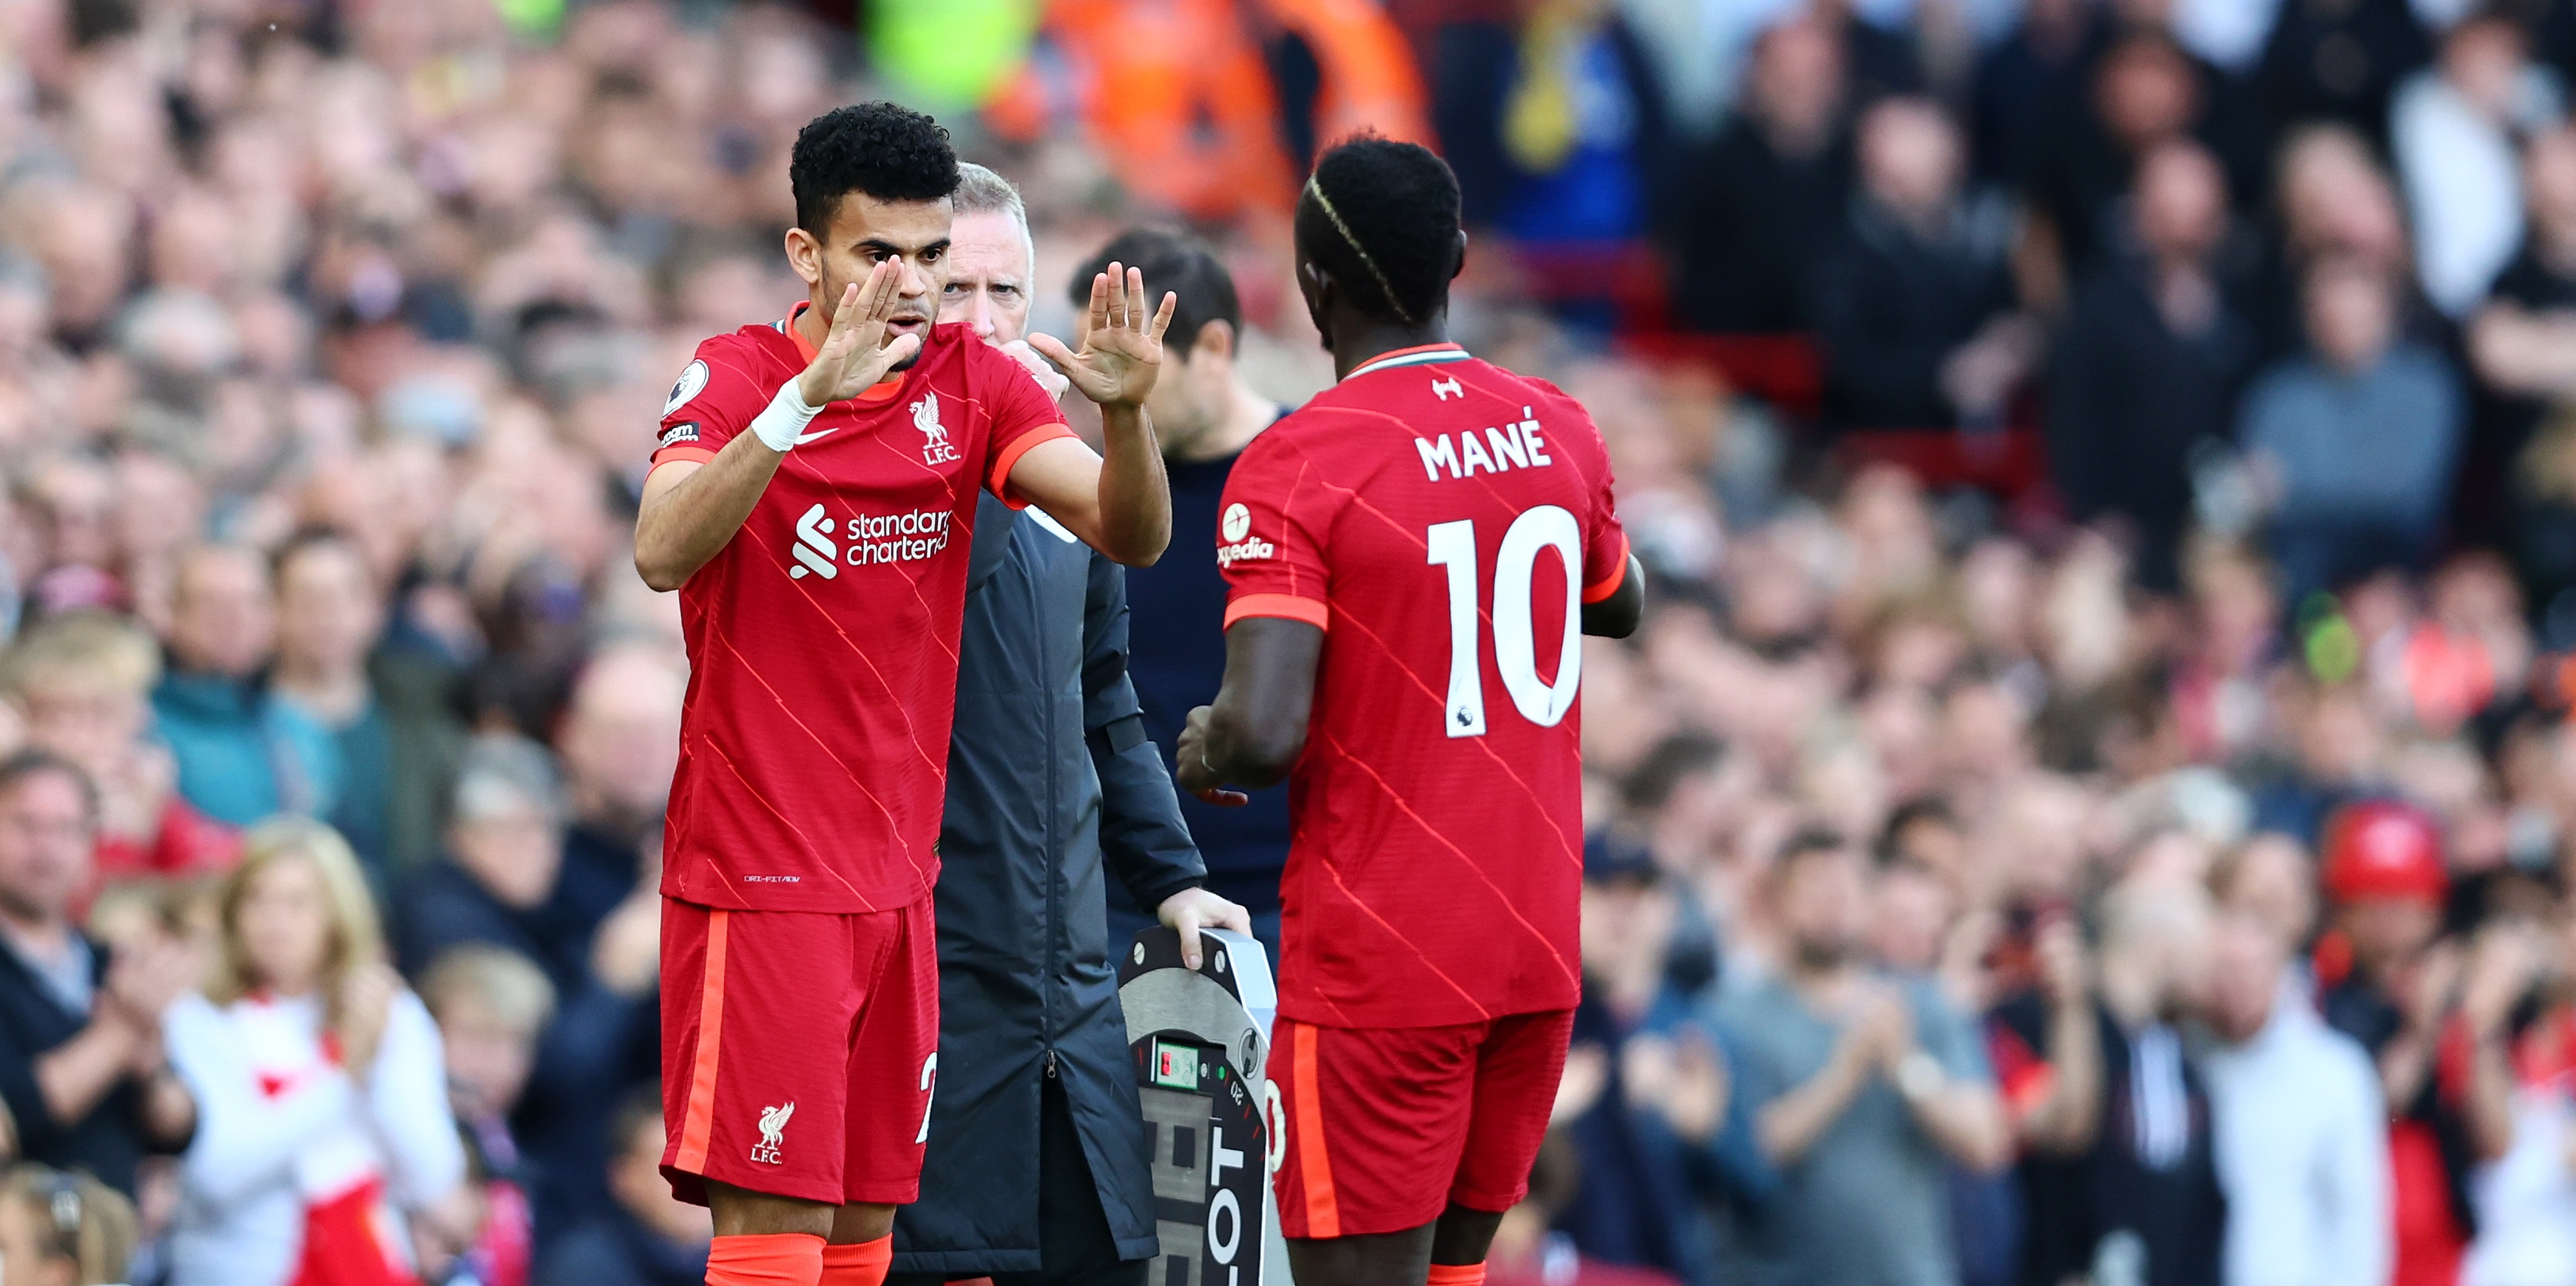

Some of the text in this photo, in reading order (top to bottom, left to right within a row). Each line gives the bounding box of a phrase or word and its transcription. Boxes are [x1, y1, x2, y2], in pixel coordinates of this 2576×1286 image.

[923, 446, 961, 466] L.F.C.
[1414, 406, 1552, 482] MANÉ
[1427, 504, 1583, 738] 10
[750, 1147, 783, 1165] L.F.C.
[1208, 1126, 1245, 1286] OT
